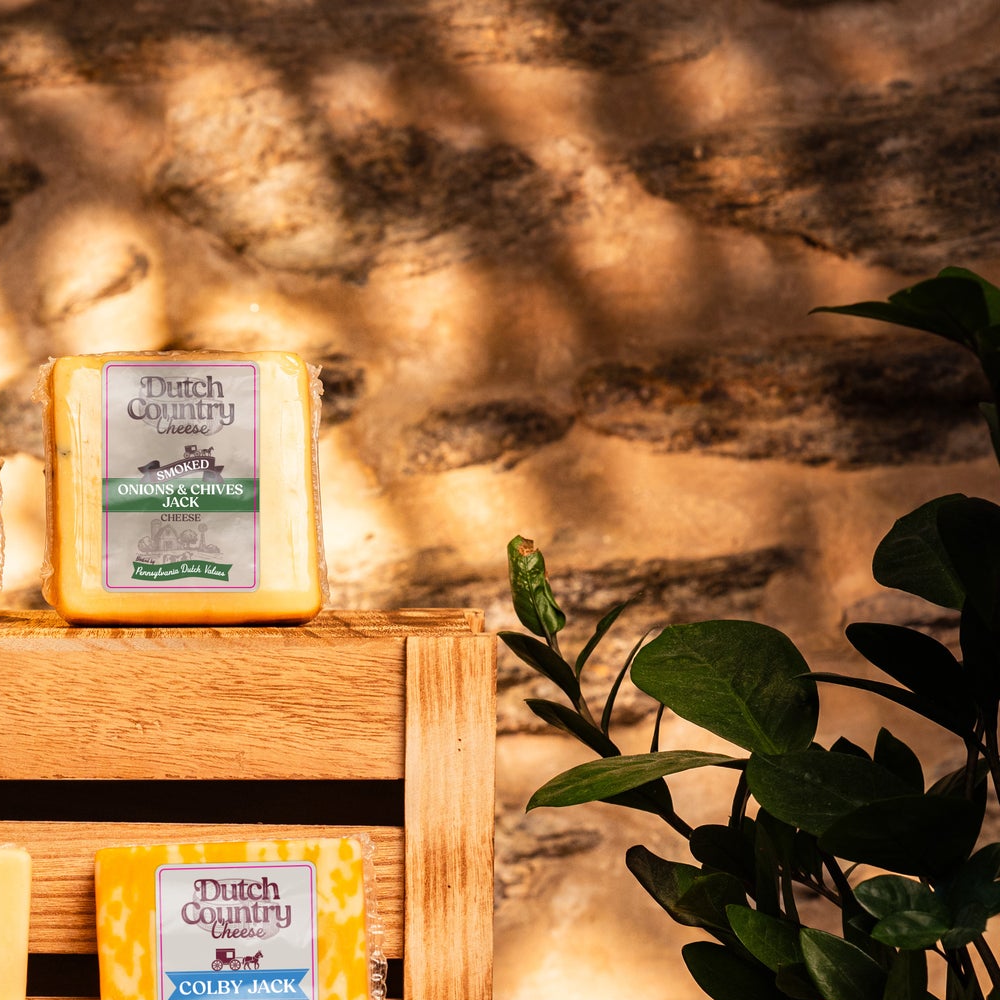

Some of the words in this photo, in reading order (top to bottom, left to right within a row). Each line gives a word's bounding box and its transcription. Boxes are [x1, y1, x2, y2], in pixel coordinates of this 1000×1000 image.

[140, 375, 224, 398] Dutch
[127, 398, 235, 425] Country
[157, 415, 210, 435] Cheese
[156, 460, 210, 480] SMOKED
[118, 484, 174, 495] ONIONS
[177, 484, 187, 495] &
[190, 484, 243, 495] CHIVES
[162, 496, 199, 508] JACK
[135, 567, 179, 579] Pennsylvania
[180, 564, 201, 573] Dutch
[204, 565, 225, 577] Values
[194, 877, 280, 902] Dutch
[181, 901, 291, 928] Country
[211, 918, 266, 939] Cheese
[179, 980, 243, 996] COLBY
[248, 979, 296, 994] JACK
